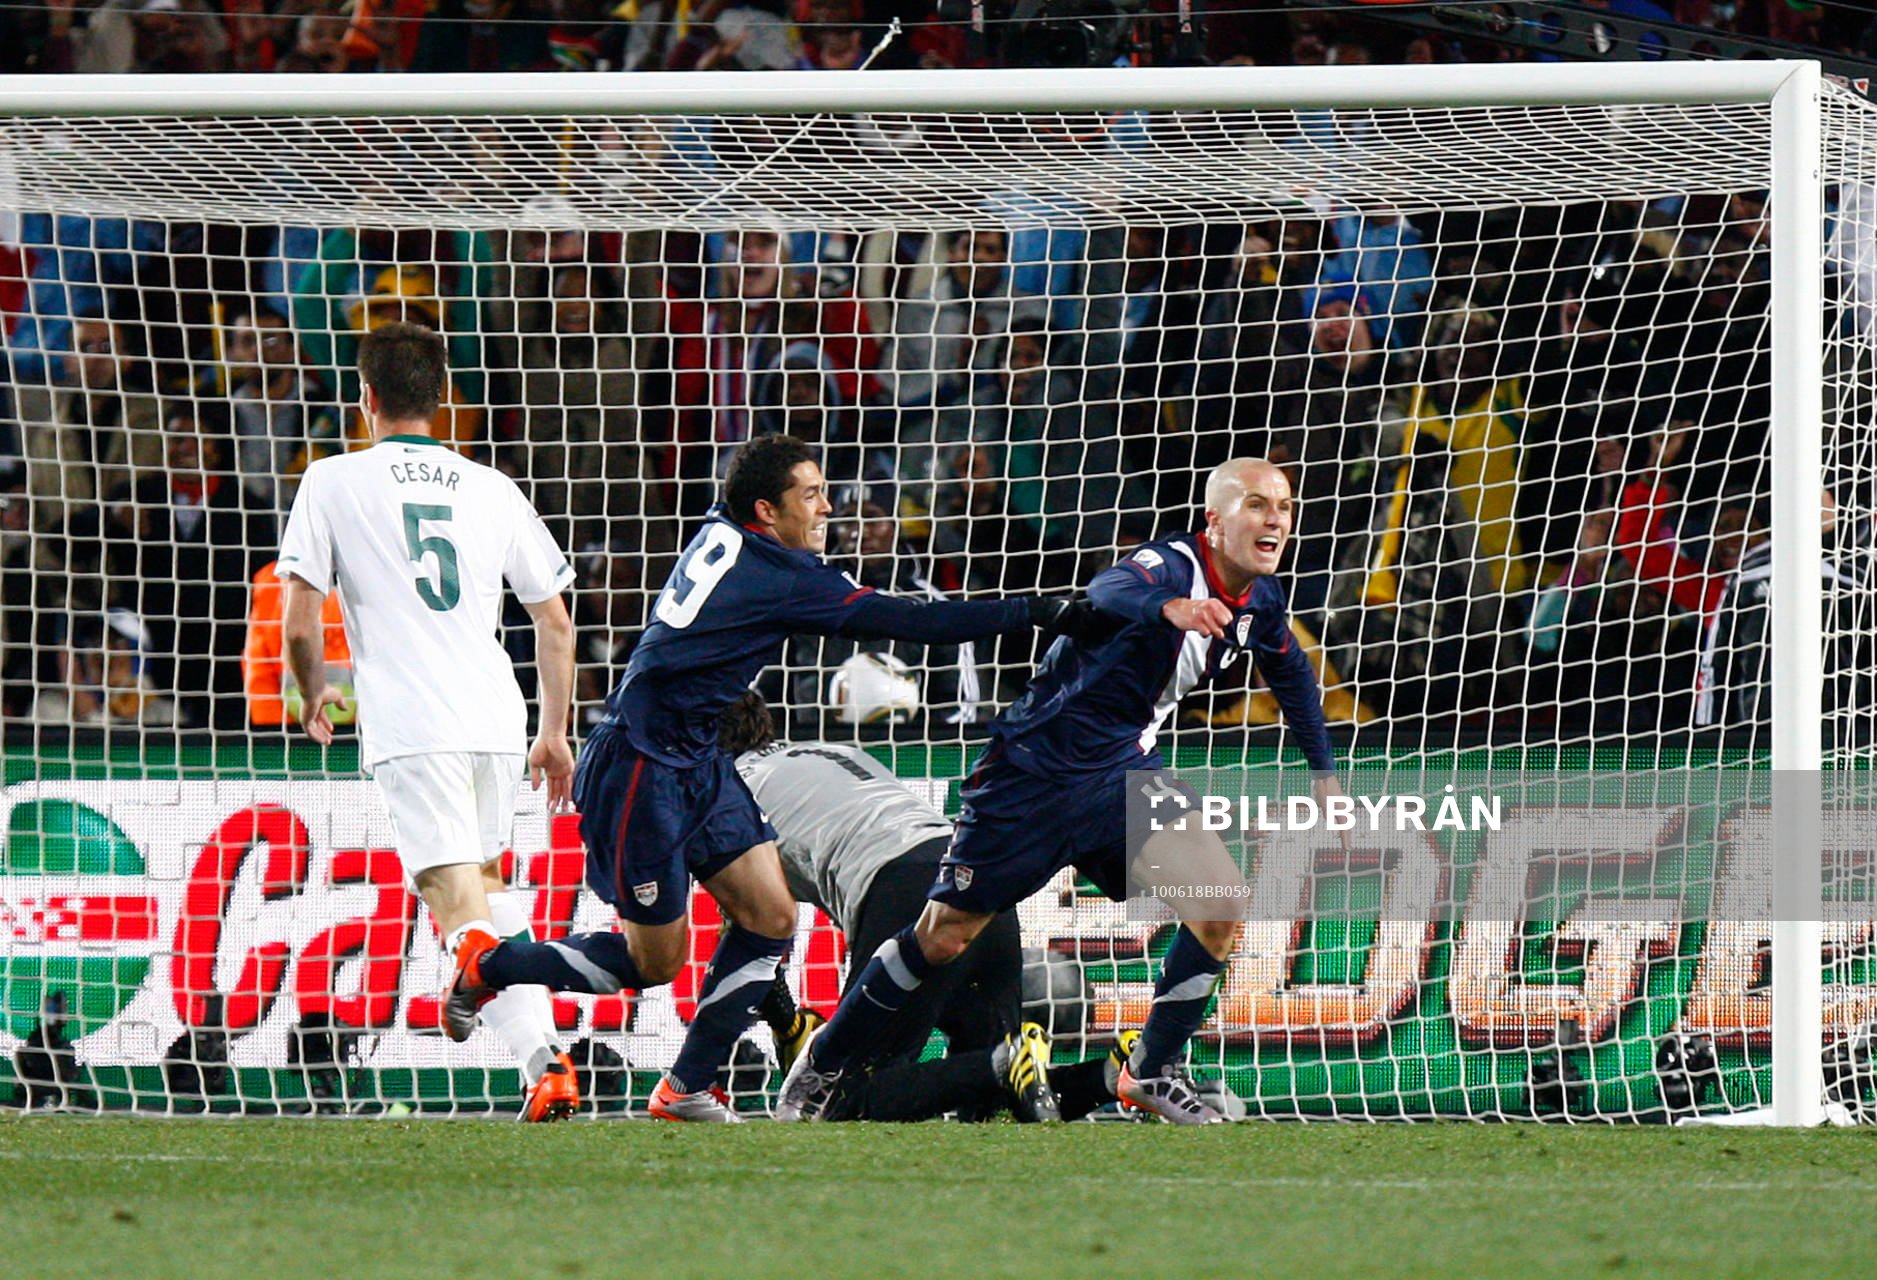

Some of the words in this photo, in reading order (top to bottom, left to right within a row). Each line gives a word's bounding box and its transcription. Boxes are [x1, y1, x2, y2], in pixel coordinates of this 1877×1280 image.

[390, 462, 460, 491] CESAR
[402, 502, 460, 612] 5
[656, 522, 743, 629] 9
